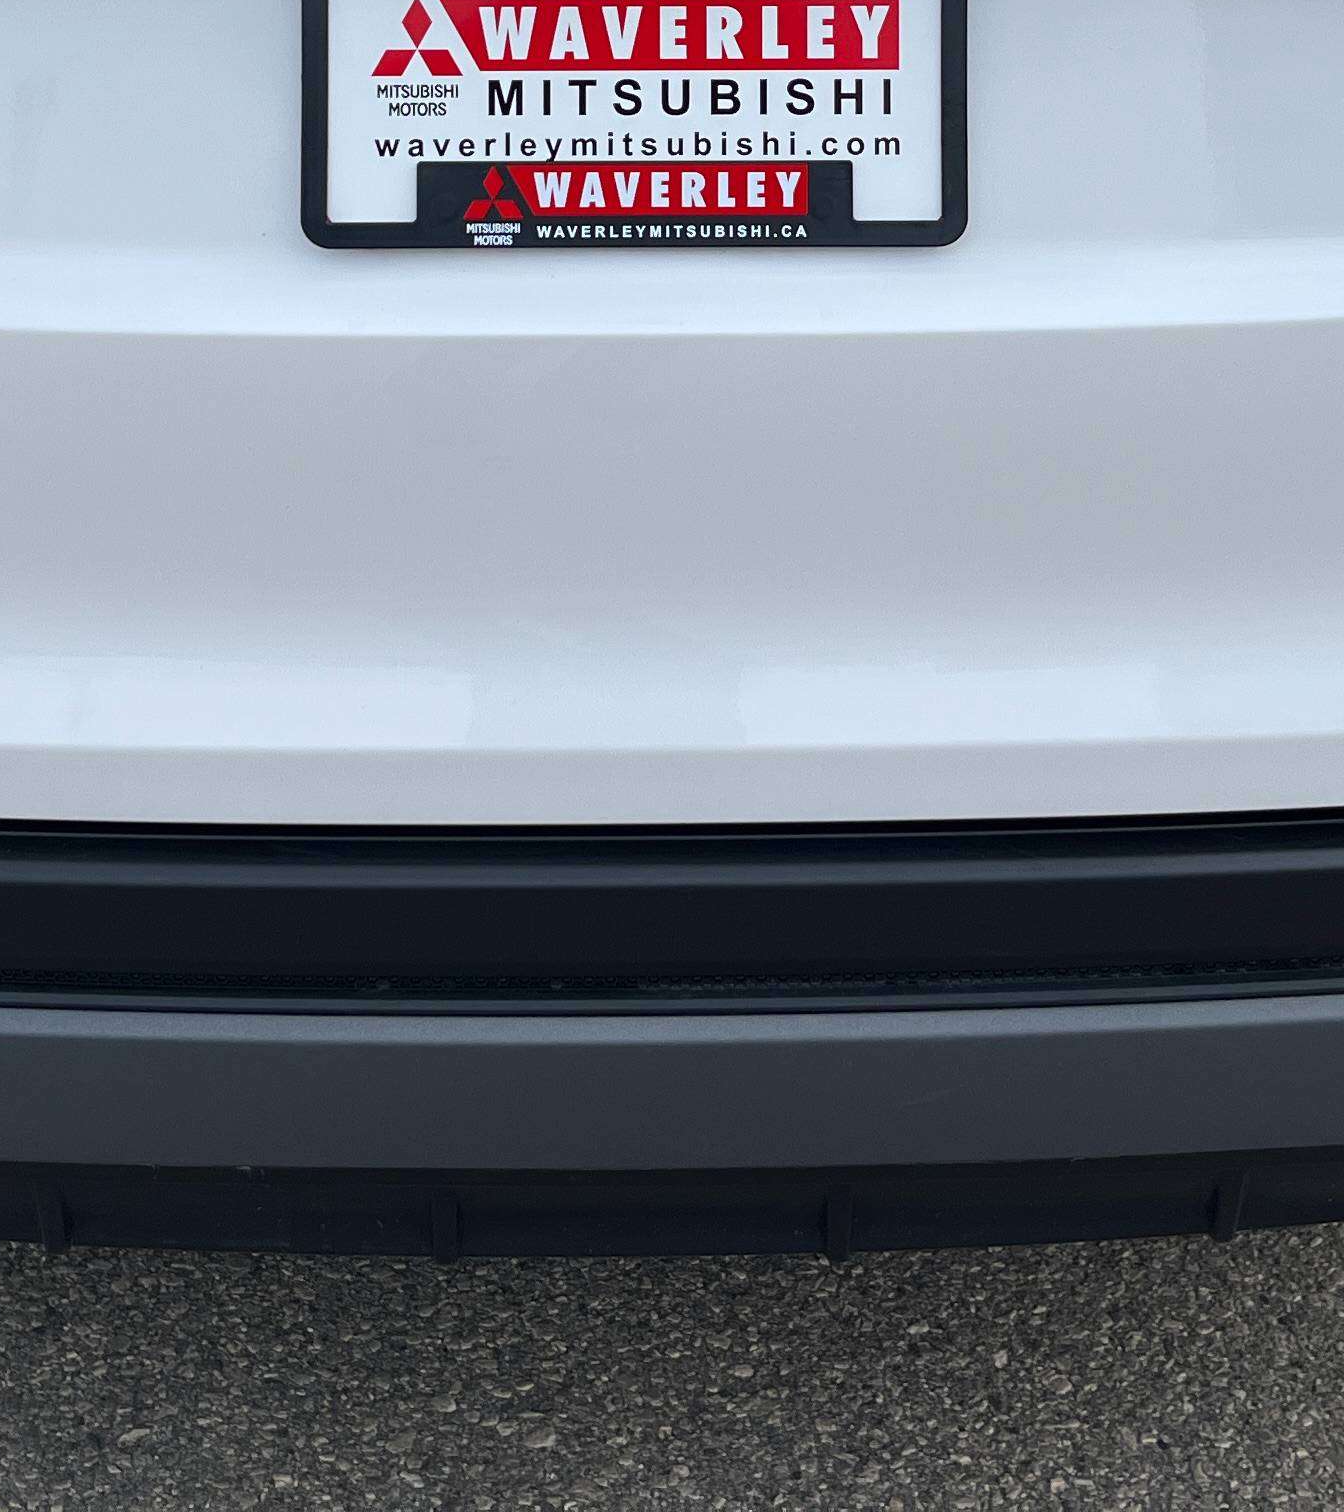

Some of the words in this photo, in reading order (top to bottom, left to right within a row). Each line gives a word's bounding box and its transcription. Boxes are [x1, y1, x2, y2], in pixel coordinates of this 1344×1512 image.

[479, 5, 890, 60] WAVERLEY
[376, 84, 459, 99] MITSUBISHI
[488, 78, 892, 116] MITSUBISHI
[388, 102, 447, 117] MOTORS
[374, 131, 901, 162] waverleymitsubishi.com
[533, 171, 802, 208] WAVERLEY
[466, 222, 521, 233] MITSUBISHI
[536, 224, 808, 239] WAVERLEYMITSUBISHI.CA
[473, 234, 513, 247] MOTORS
